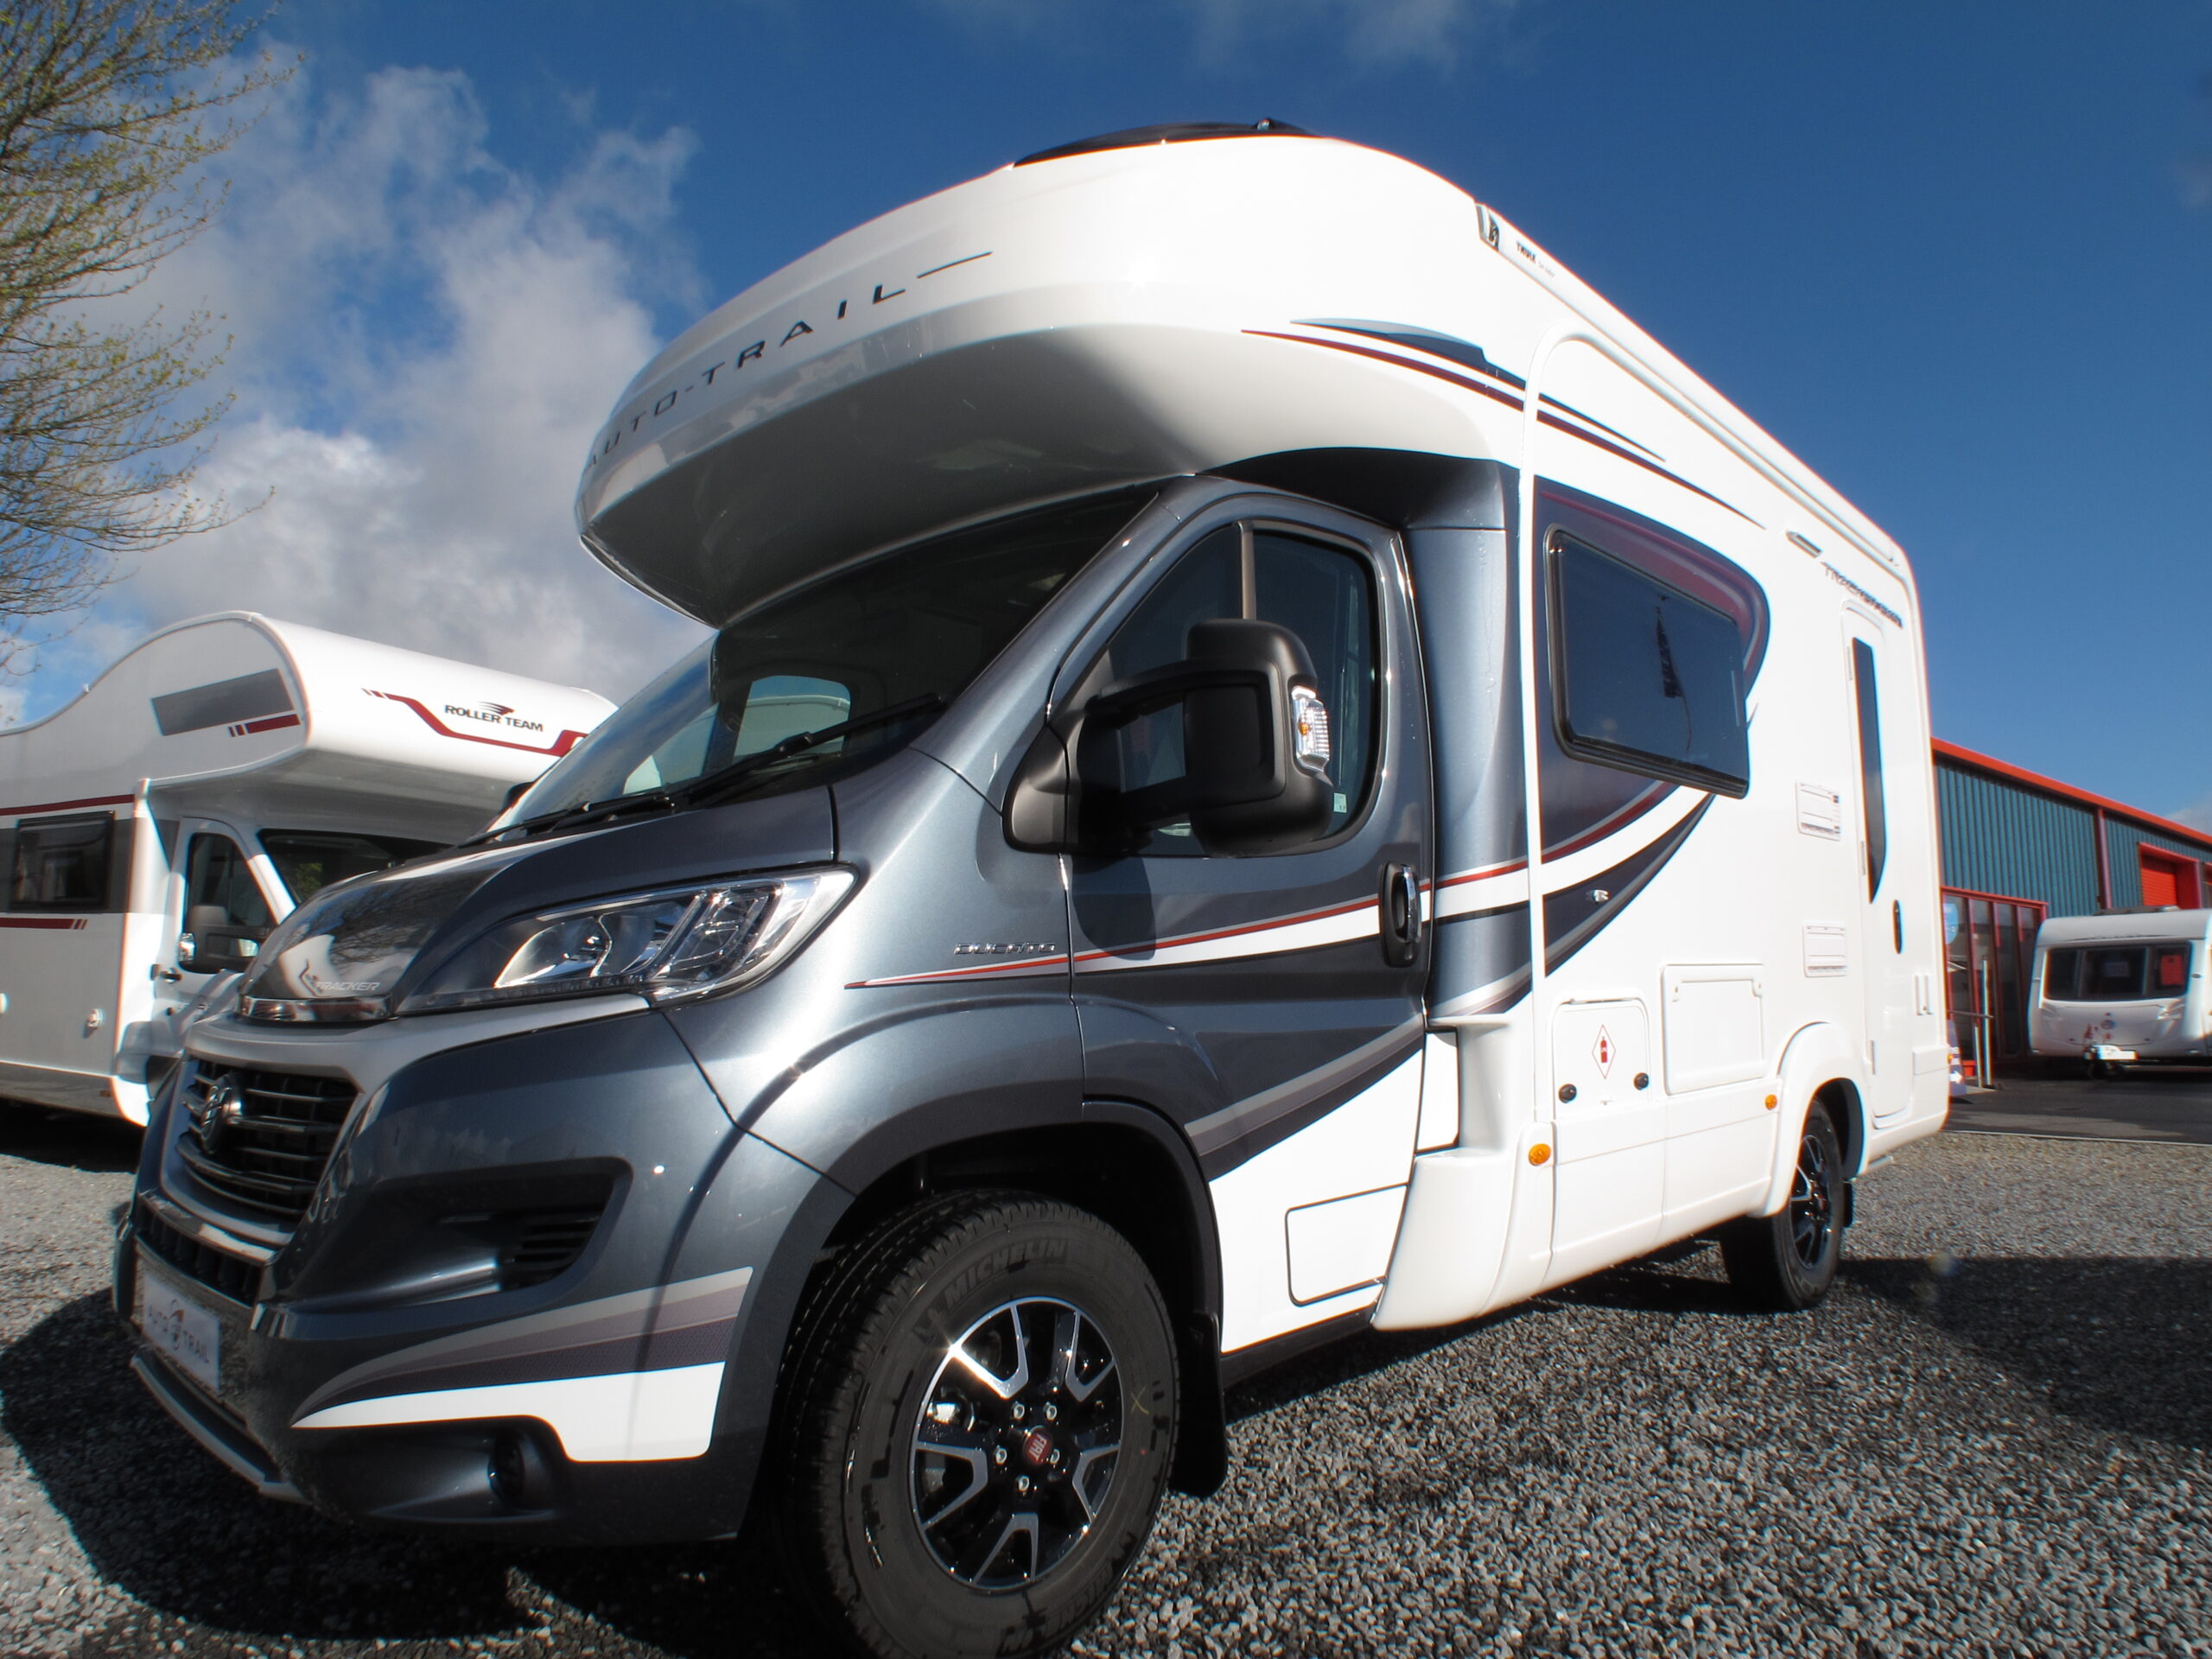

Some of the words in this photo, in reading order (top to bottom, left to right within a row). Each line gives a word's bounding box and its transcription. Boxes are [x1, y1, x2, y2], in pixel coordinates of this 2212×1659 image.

[444, 704, 502, 724] ROLLER
[505, 716, 543, 733] TEAM
[944, 1238, 1069, 1313] MICHELIN
[1027, 1432, 1048, 1461] FIAT
